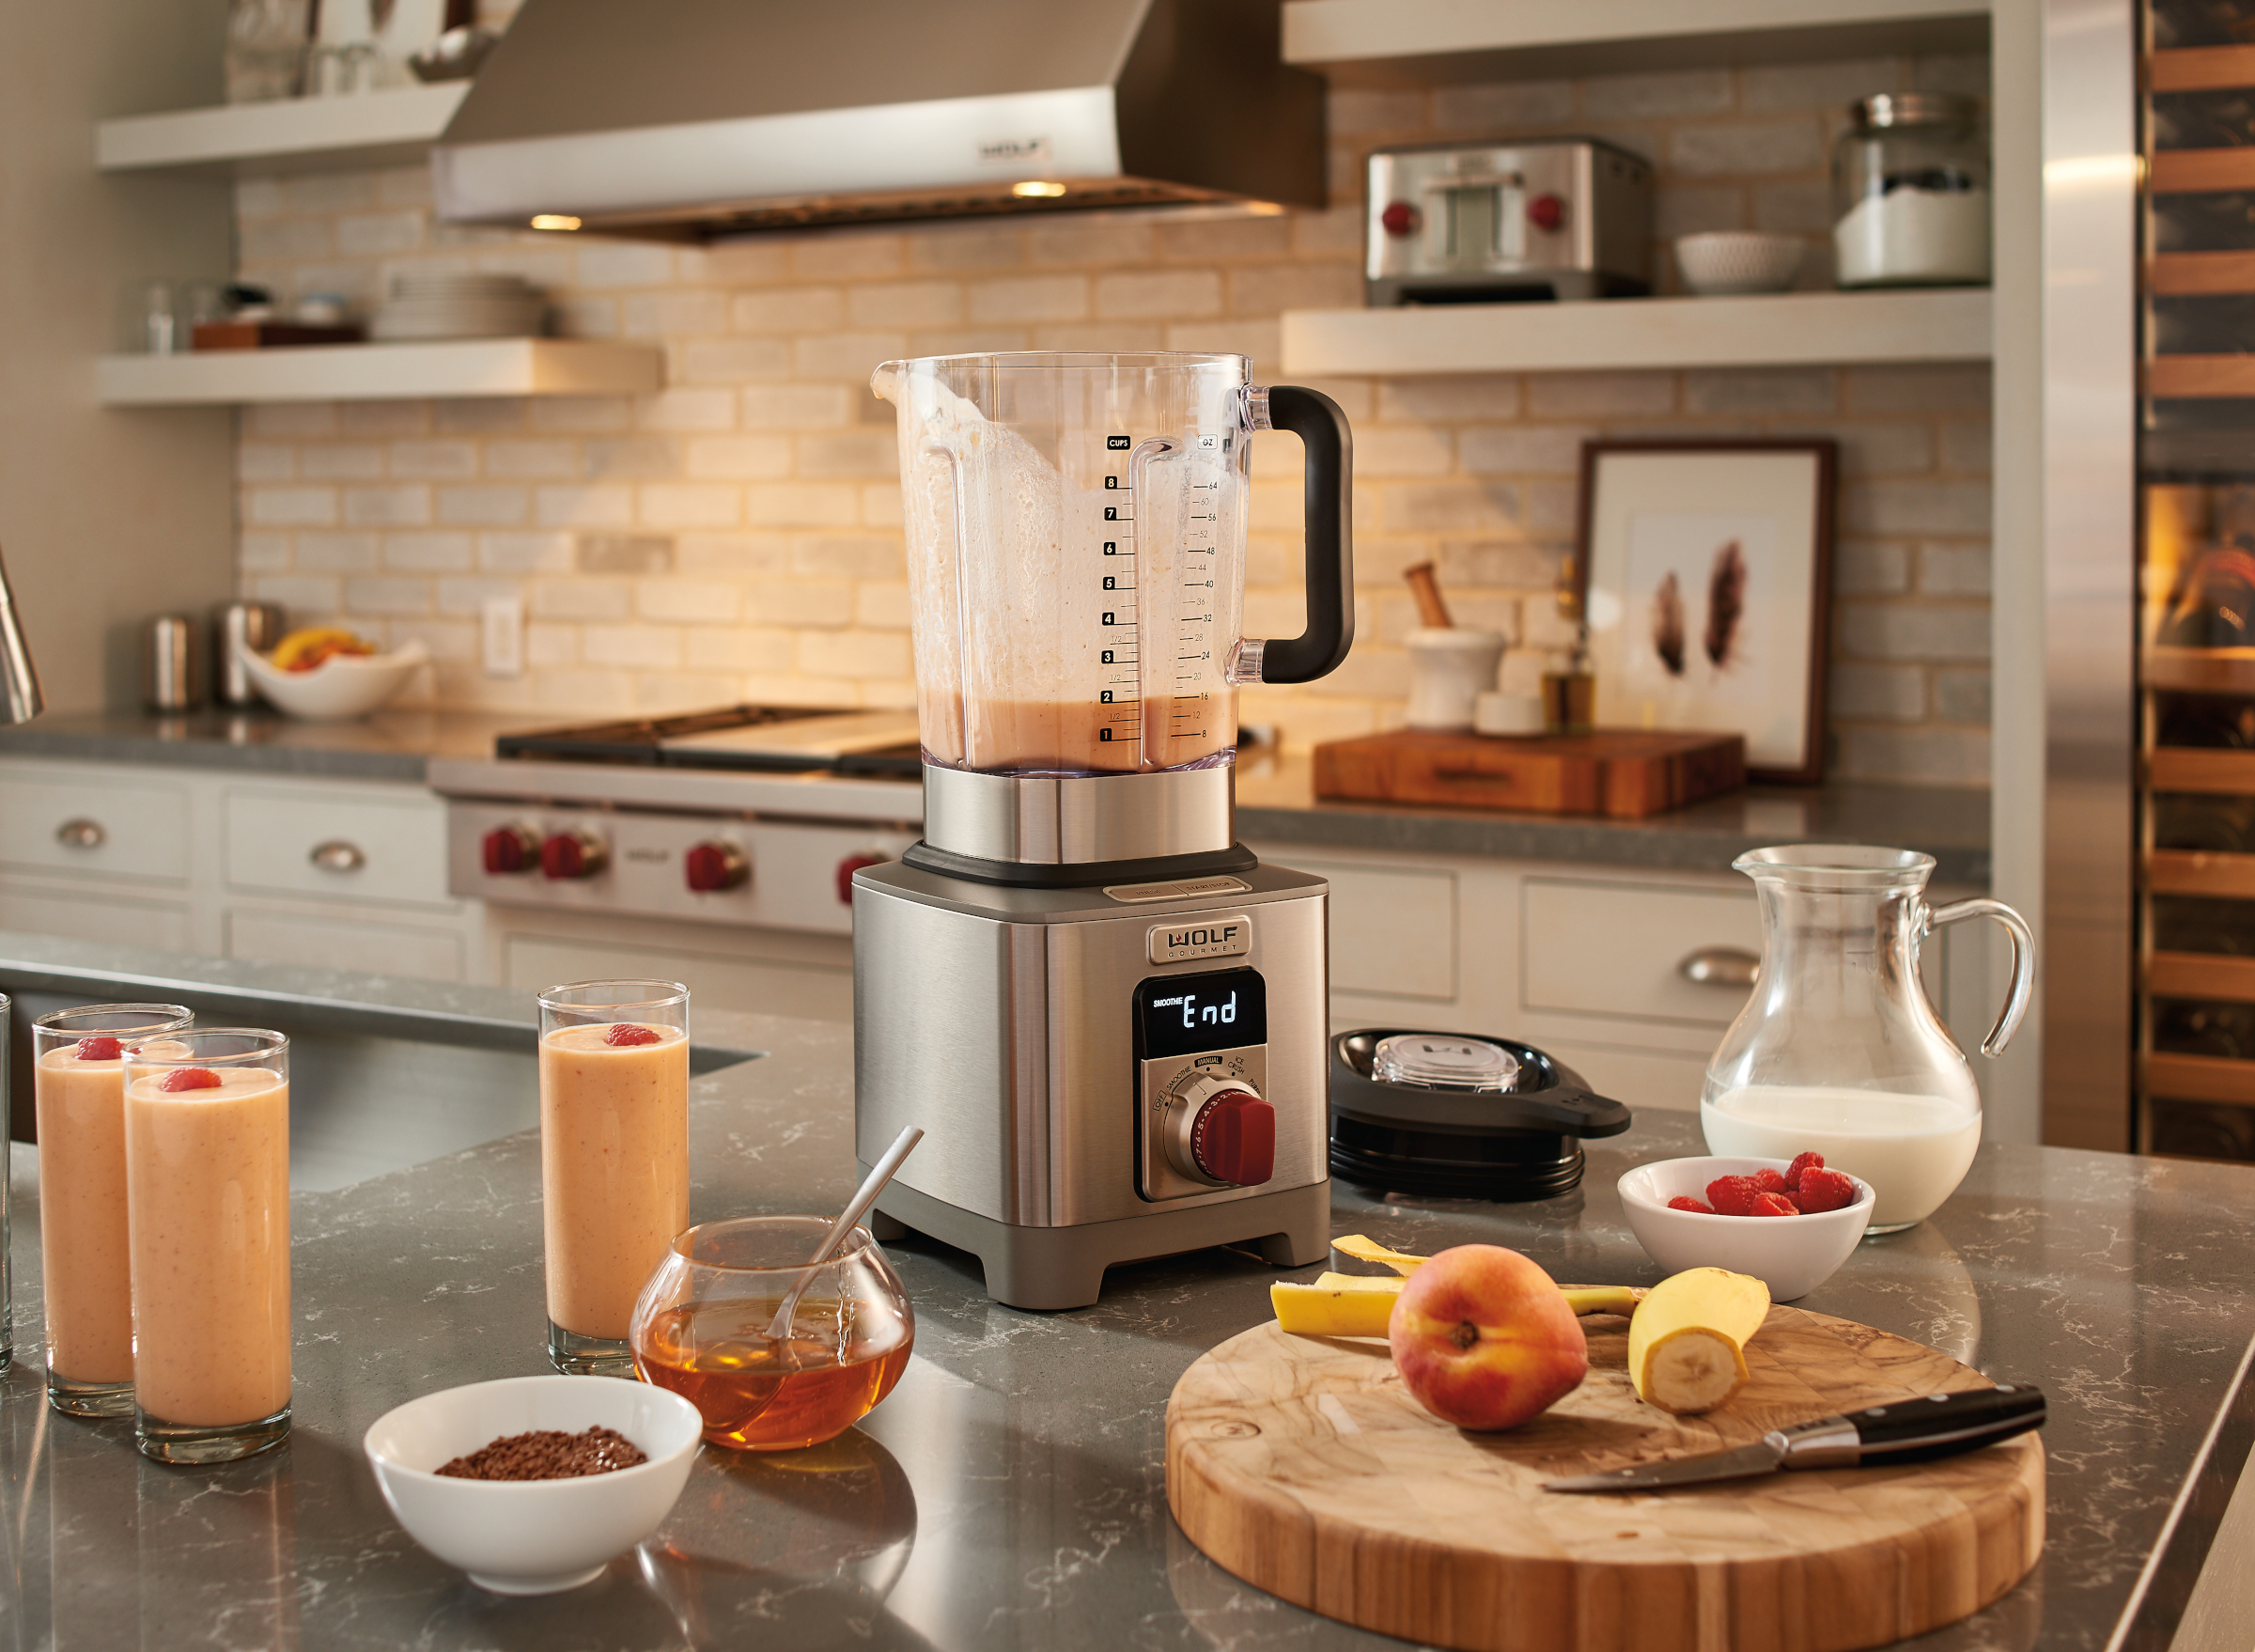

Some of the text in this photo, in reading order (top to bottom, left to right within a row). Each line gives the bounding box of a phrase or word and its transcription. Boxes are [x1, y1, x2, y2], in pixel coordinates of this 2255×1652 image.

[1109, 439, 1128, 447] CUPS
[1202, 438, 1214, 446] OZ
[1208, 481, 1218, 490] 64
[1200, 497, 1209, 506] 60
[1207, 513, 1217, 522] 56
[1199, 530, 1208, 538] 52
[1205, 547, 1215, 555] 48
[1205, 580, 1214, 588] 40
[1196, 598, 1205, 606] 36
[1203, 614, 1212, 622] 32
[1194, 633, 1204, 642] 28
[1201, 651, 1210, 660] 24
[1193, 672, 1202, 680] 20
[1200, 692, 1209, 701] 16
[1192, 710, 1201, 719] 12
[1168, 926, 1238, 948] WOLF
[1168, 944, 1237, 958] GOURMET
[1153, 990, 1236, 1029] SMOOTHIE End
[1197, 1056, 1220, 1066] MANUAL
[1235, 1055, 1245, 1066] ICE
[1227, 1061, 1246, 1075] CRUSH
[1166, 1065, 1192, 1091] SMOOTHIE
[1155, 1093, 1165, 1109] OFF
[1197, 1122, 1204, 1130] 5
